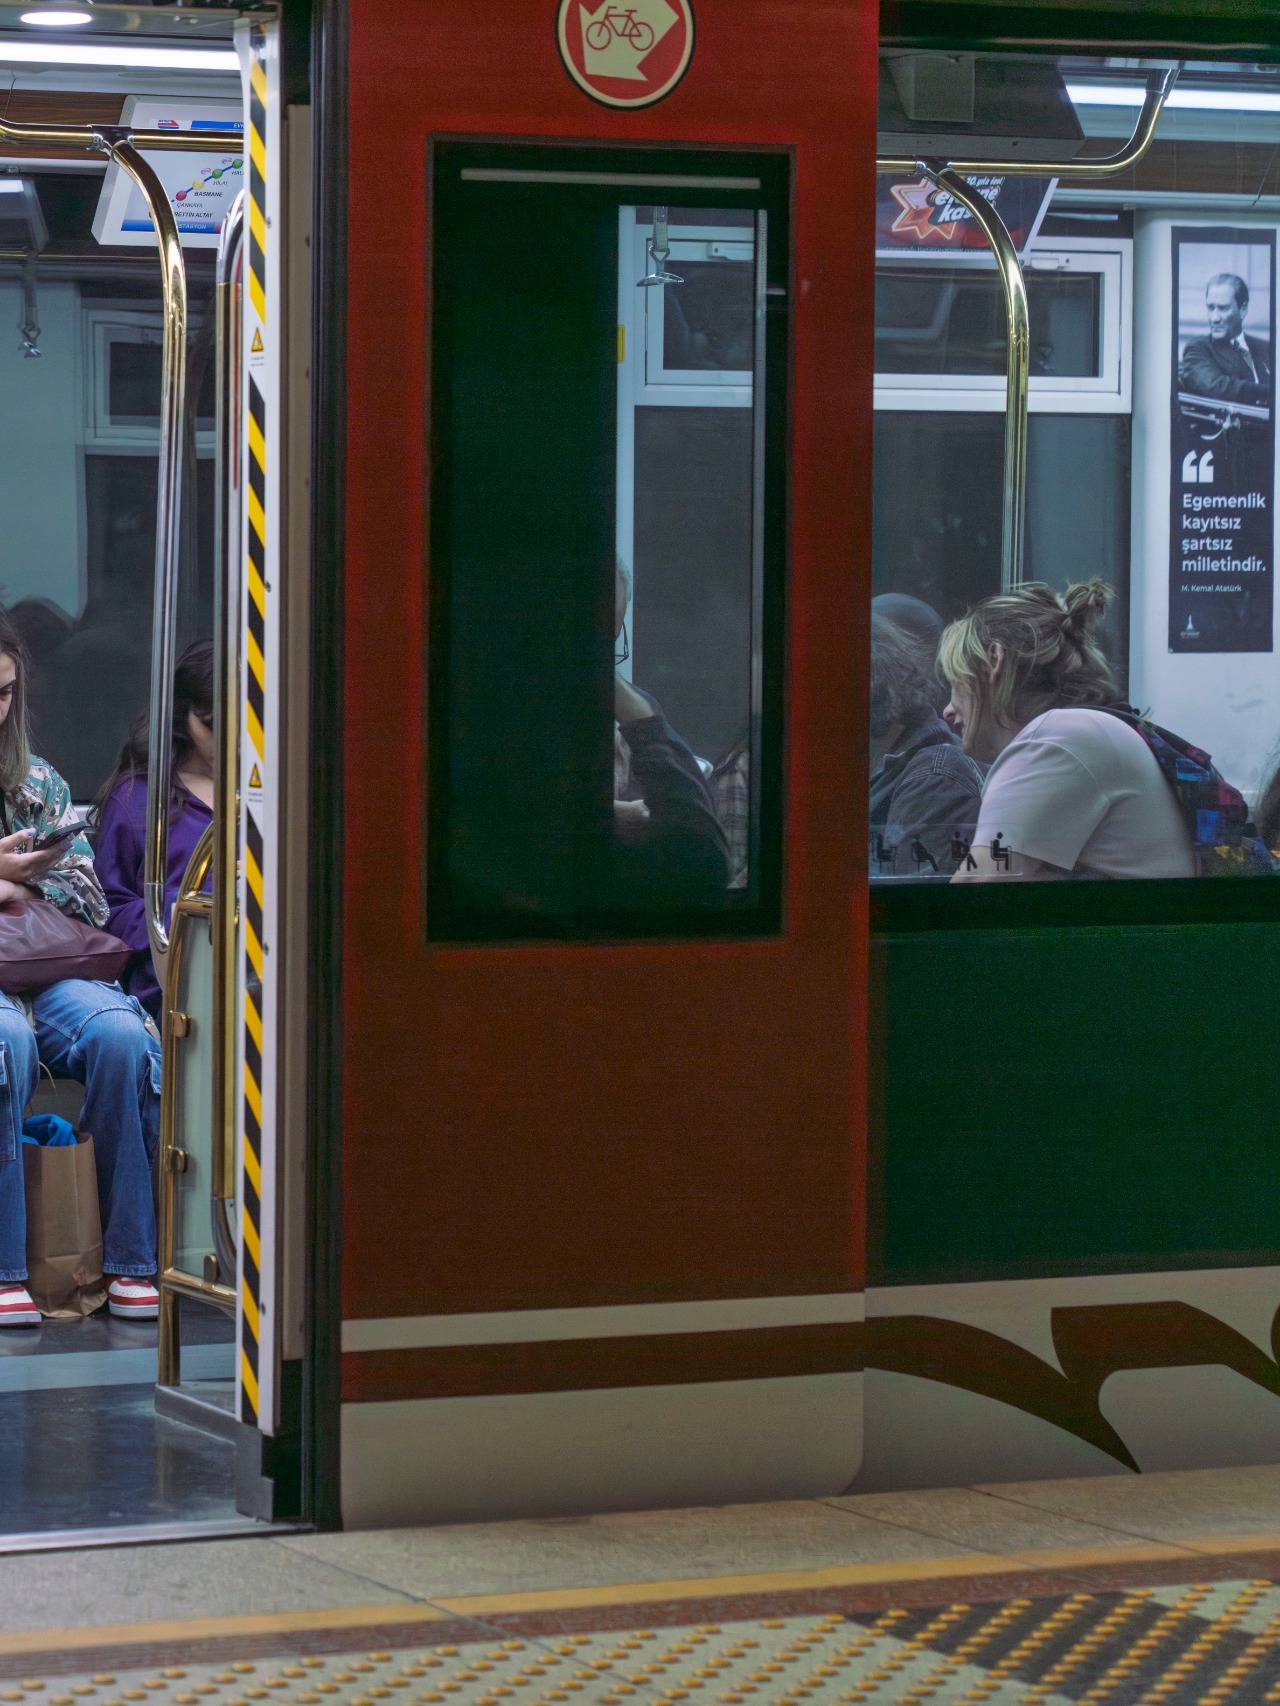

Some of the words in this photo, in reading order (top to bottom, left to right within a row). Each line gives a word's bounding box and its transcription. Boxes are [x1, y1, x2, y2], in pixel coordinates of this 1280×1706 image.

[1182, 492, 1266, 511] Egemenlik
[1182, 514, 1241, 533] kayıtsız
[1181, 536, 1233, 554] şartsız
[1182, 555, 1266, 572] milletindir.
[1191, 584, 1214, 592] Kemal
[1215, 584, 1242, 592] Atatürk
